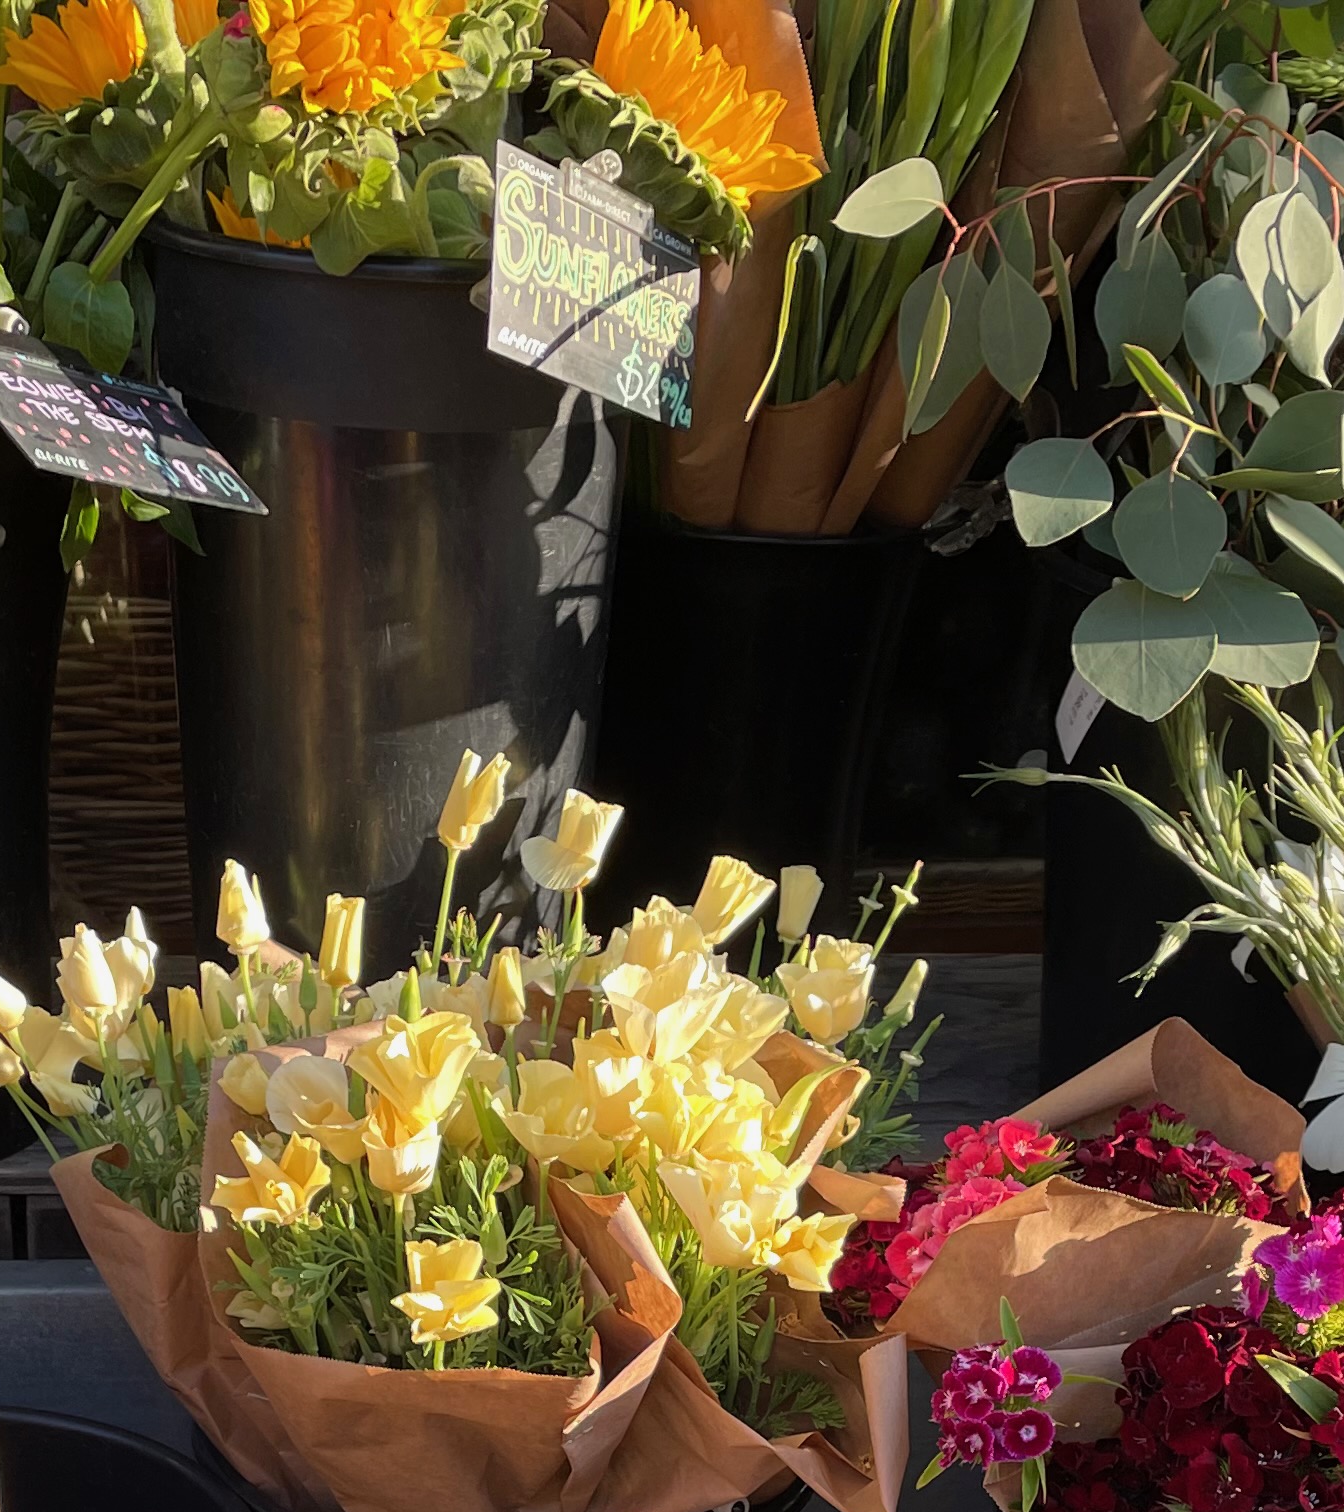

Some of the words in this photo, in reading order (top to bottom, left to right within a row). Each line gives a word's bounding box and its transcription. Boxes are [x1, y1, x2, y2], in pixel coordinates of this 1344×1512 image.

[517, 158, 555, 187] ORGANIC
[25, 398, 80, 426] THE
[142, 442, 250, 502] $8.99
